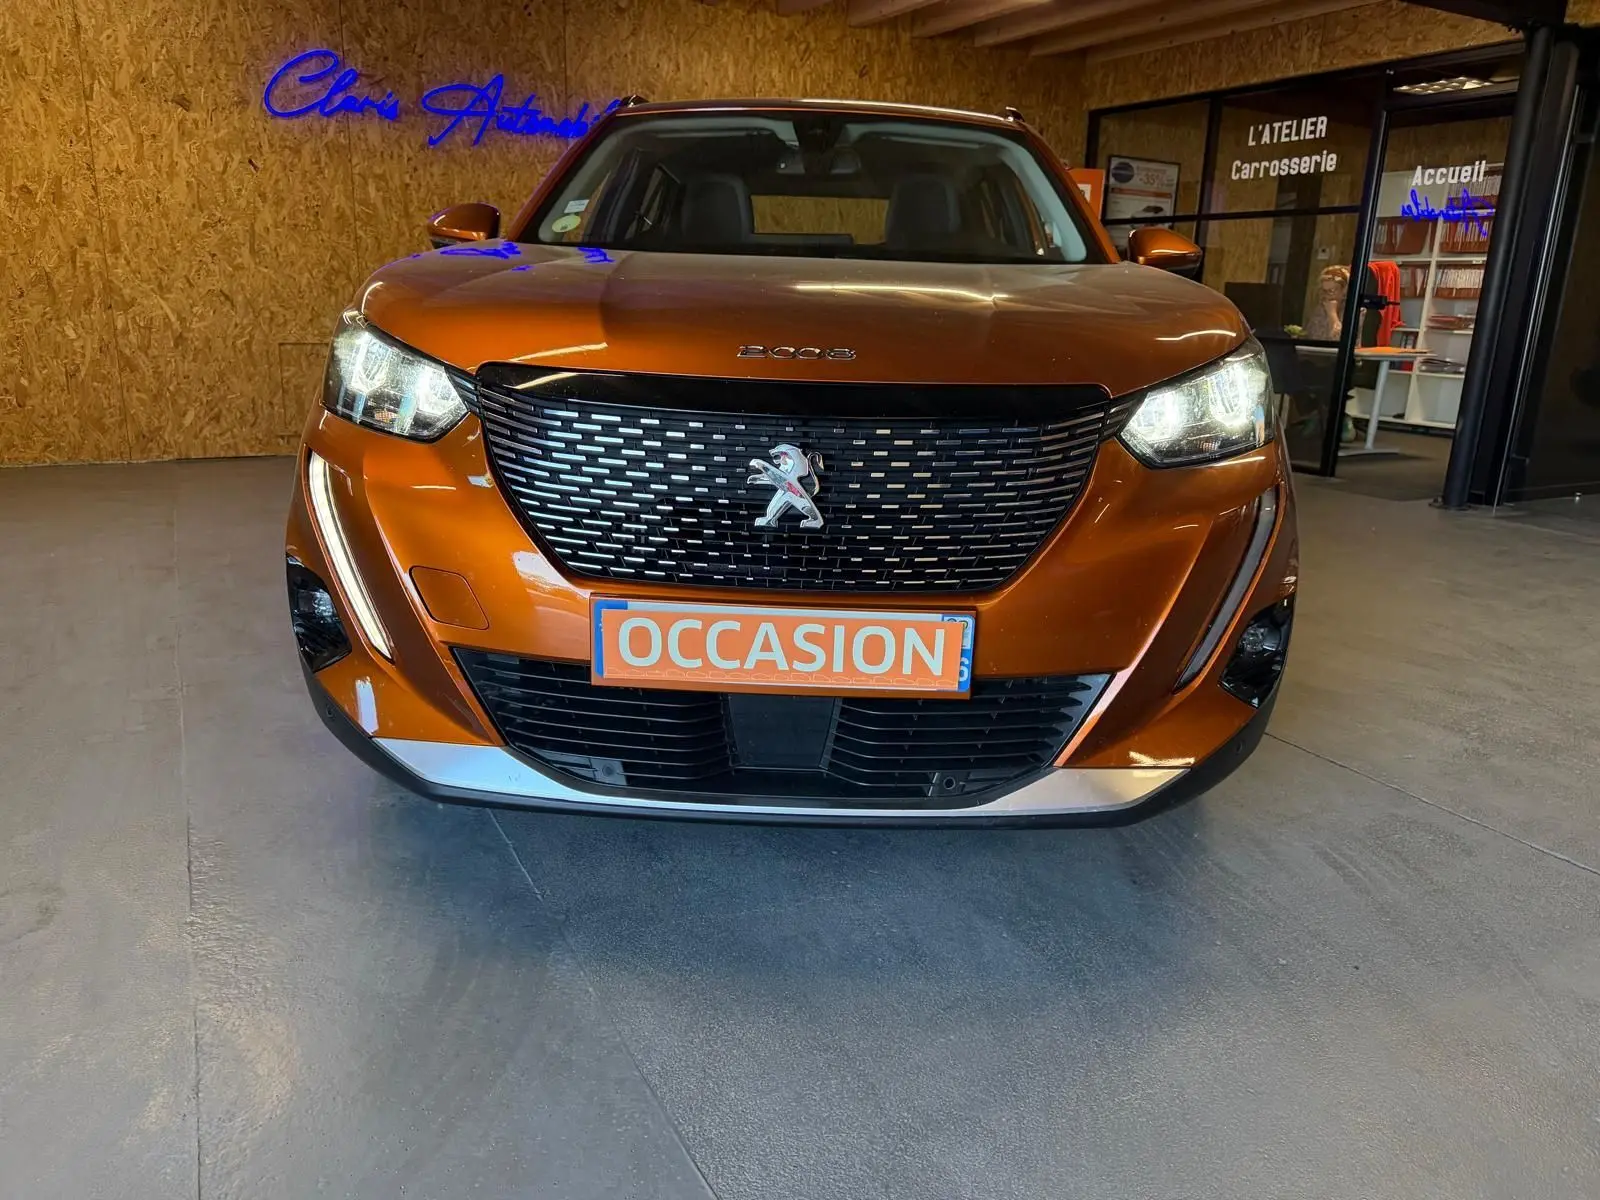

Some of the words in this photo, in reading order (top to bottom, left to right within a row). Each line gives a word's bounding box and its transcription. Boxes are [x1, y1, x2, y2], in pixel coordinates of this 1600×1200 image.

[1248, 116, 1328, 146] L'ATELIER
[1231, 150, 1337, 181] Carrosserie
[1411, 160, 1487, 187] Accueil
[736, 345, 857, 361] 2008
[618, 616, 946, 677] OCCASION
